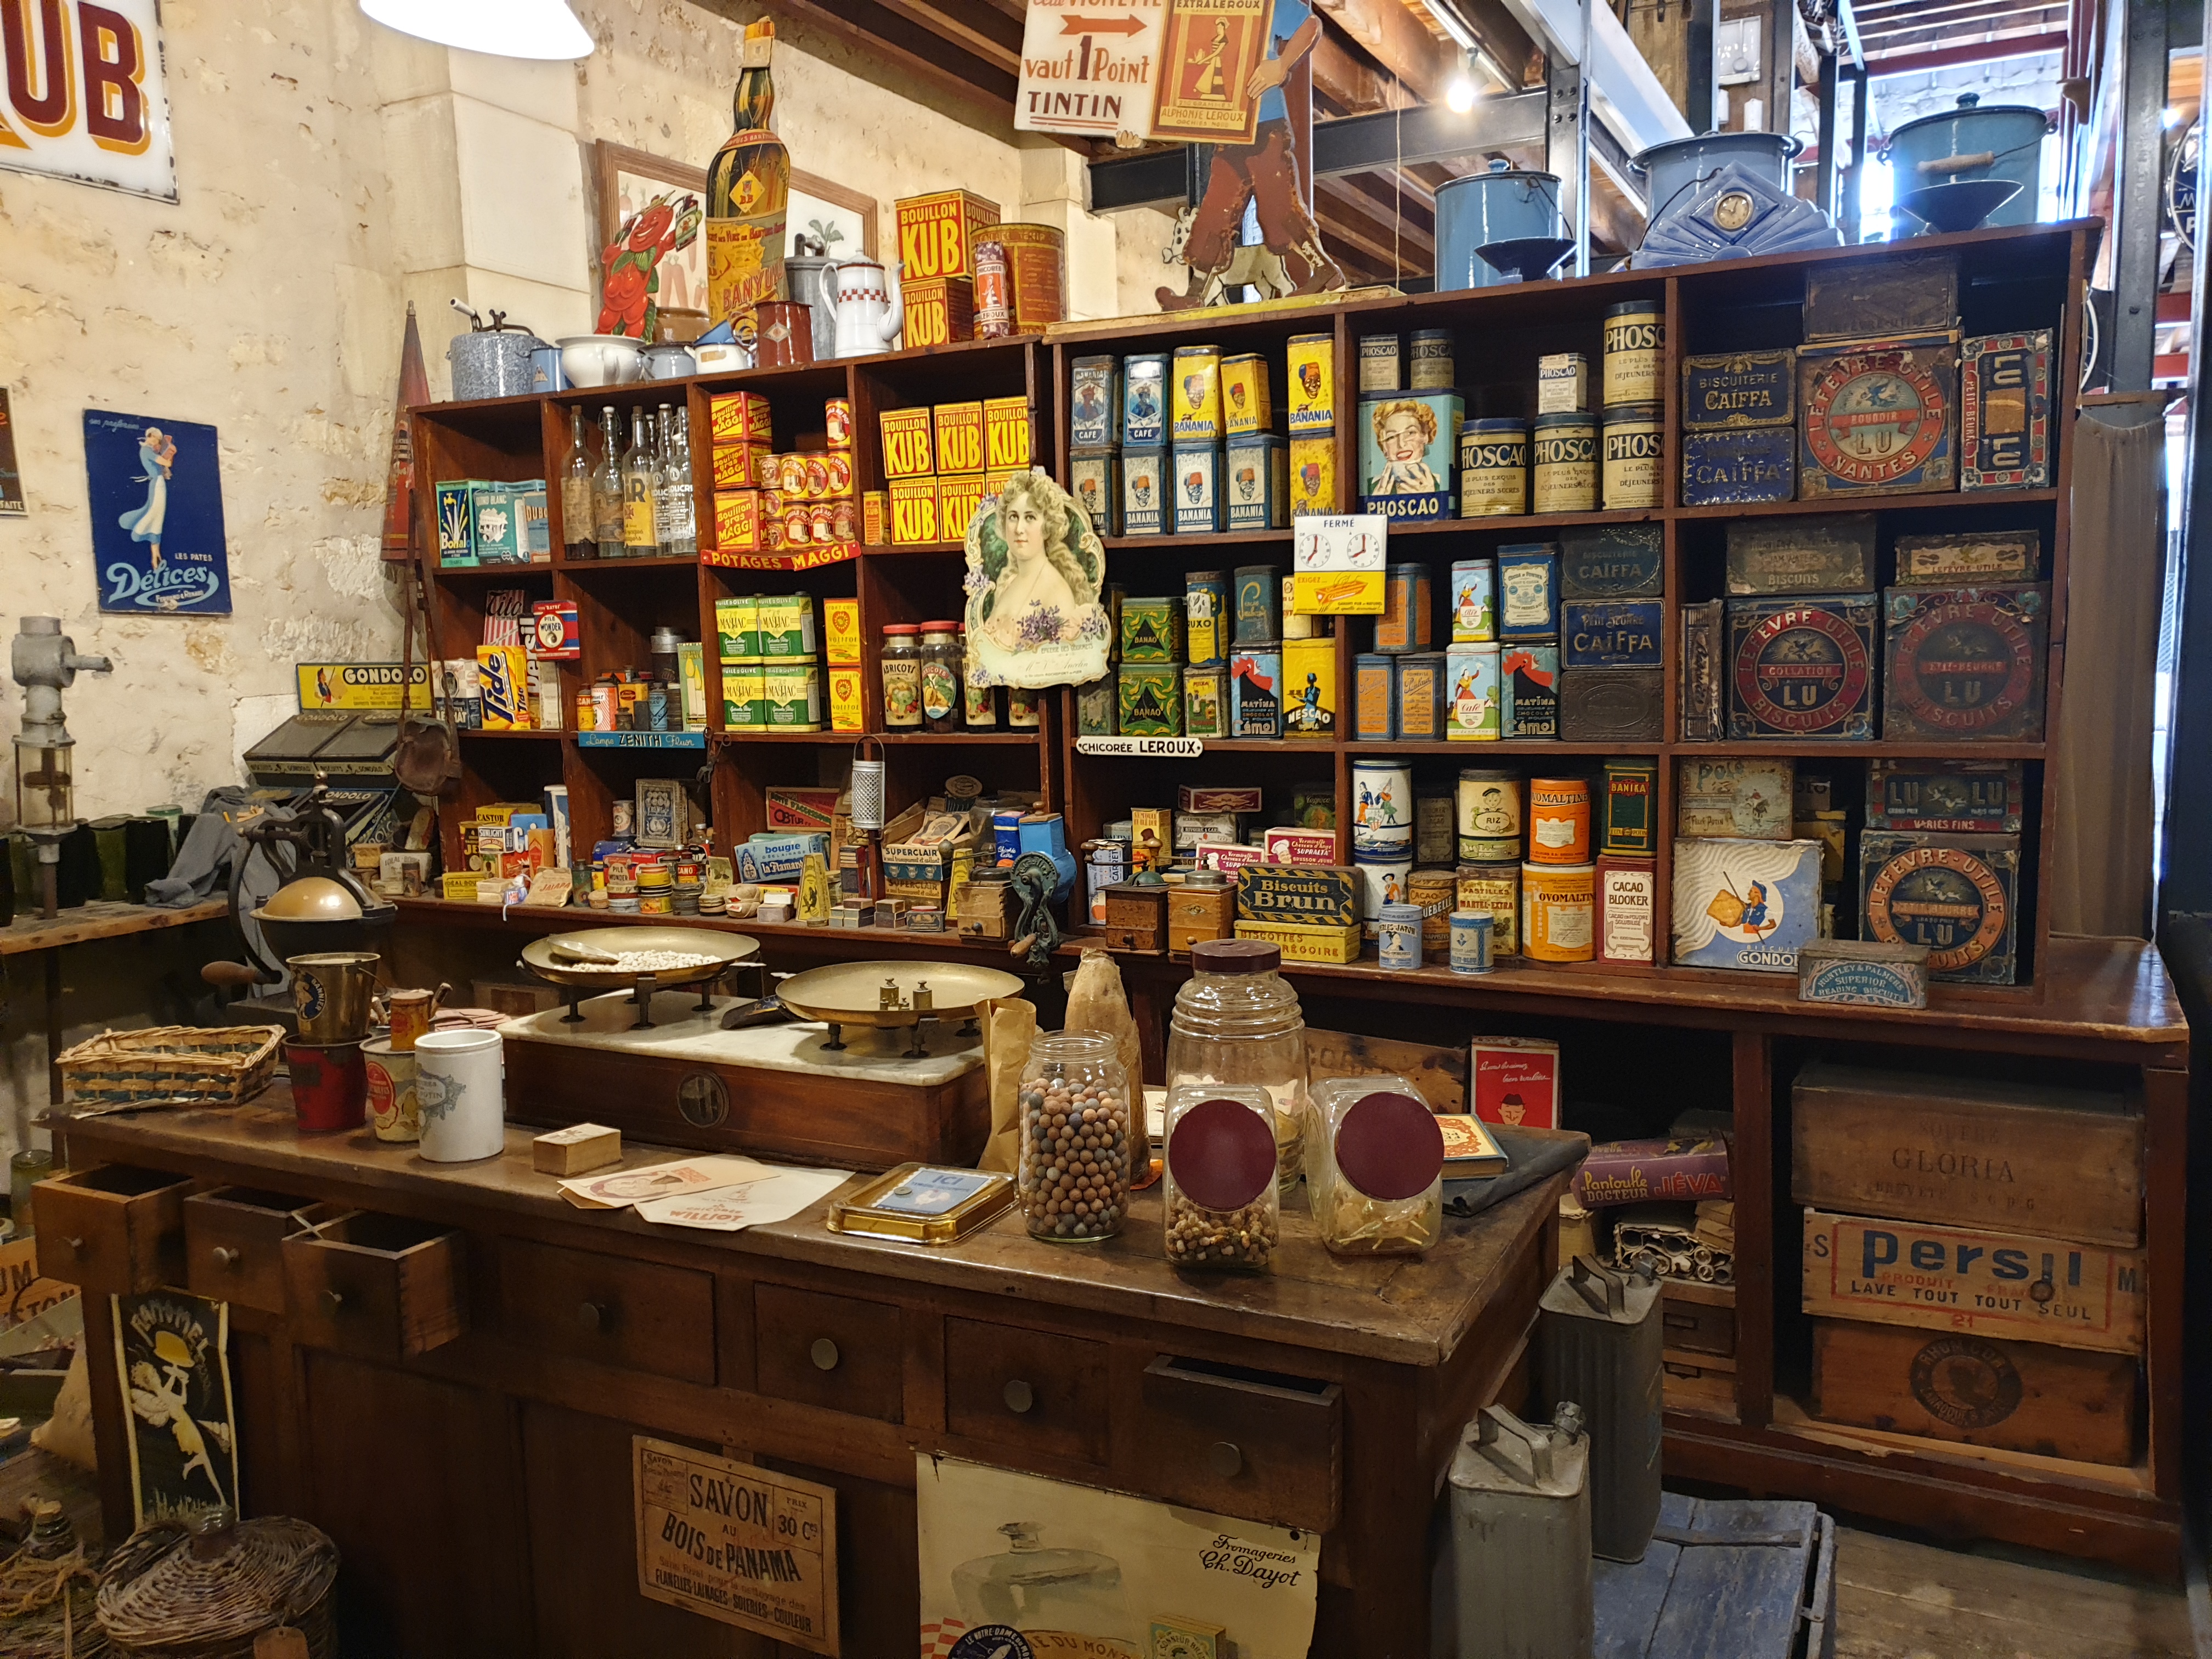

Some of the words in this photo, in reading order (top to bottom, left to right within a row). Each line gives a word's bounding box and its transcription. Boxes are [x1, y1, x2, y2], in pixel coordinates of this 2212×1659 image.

[1213, 1, 1260, 9] LEROUX
[1024, 50, 1073, 80] vaut
[1077, 35, 1092, 80] 1
[1092, 48, 1150, 83] Point
[0, 0, 151, 155] UB
[1028, 91, 1121, 119] TINTIN
[1161, 108, 1203, 120] ALPHONSE
[1206, 109, 1243, 121] LEROUX
[901, 202, 957, 225] BOUILLON
[966, 203, 999, 223] BOUILLON
[901, 219, 960, 279] KUB
[723, 257, 784, 312] BANYULS
[905, 288, 943, 304] BOUILLON
[980, 311, 1006, 319] LEROUX
[906, 301, 946, 348] KUB
[1361, 346, 1397, 356] PHOSCAO
[1540, 367, 1576, 379] PHOSCAO
[1993, 354, 2023, 385] LU
[1699, 371, 1778, 388] BISCUITERIE
[1705, 388, 1773, 410] CAÏFFA
[712, 402, 741, 421] Bouillon
[717, 411, 735, 424] gras
[938, 413, 978, 426] BOUILLON
[988, 408, 1028, 422] BOUILLON
[1289, 409, 1332, 424] BANANIA
[1850, 411, 1898, 424] BOUDOIR
[713, 413, 742, 434] MAGGI
[884, 418, 926, 433] BOUILLON
[1174, 420, 1215, 433] BANANIA
[1226, 416, 1257, 429] BANANIA
[938, 425, 981, 470] KUB
[988, 420, 1029, 466] KUB
[1855, 432, 1892, 454] LU
[714, 450, 743, 468] Bouillon
[885, 430, 929, 475] KUB
[1462, 445, 1526, 467] HOSCAO
[1993, 438, 2022, 466] LU
[714, 462, 744, 483] MAGGI
[719, 458, 738, 471] gras
[1830, 450, 1918, 479] NANTES
[630, 478, 645, 503] R
[892, 486, 933, 500] BOUILLON
[941, 483, 981, 496] BOUILLON
[717, 504, 751, 523] Bouillon
[1178, 509, 1212, 521] BANANIA
[1231, 506, 1263, 518] BANANIA
[1367, 498, 1439, 517] PHOSCAO
[725, 514, 745, 526] gras
[893, 499, 935, 541] KUB
[1126, 514, 1159, 525] BANANIA
[1324, 518, 1355, 527] FERMÉ
[718, 520, 752, 543] MAGGI
[190, 554, 213, 562] PATES
[712, 552, 782, 569] POTAGES
[793, 545, 849, 569] MAGGI
[106, 559, 208, 603] Délices
[1768, 573, 1819, 585] BISCUITS
[540, 623, 562, 631] WONDER
[1573, 632, 1653, 653] CAÏFFA
[345, 668, 425, 684] GONDOO
[883, 663, 917, 676] ABRICOTS
[1769, 665, 1832, 677] COLLATION
[478, 651, 516, 724] Tide
[1783, 684, 1818, 707] LU
[1944, 681, 1981, 703] LU
[517, 688, 527, 712] Tide
[1460, 702, 1481, 712] Café
[1134, 708, 1161, 716] BANAO
[1288, 708, 1330, 725] NESCAO
[1751, 697, 1847, 729] BISCUITS
[1911, 695, 2013, 729] BISCUITS
[586, 733, 614, 746] Lampe
[619, 734, 662, 747] ZENITH
[665, 735, 695, 746] Fluor
[1081, 742, 1133, 752] CHICORÉE
[1139, 741, 1195, 754] LEROUX
[1611, 782, 1646, 793] BANIKA
[1889, 782, 1918, 805] LU
[1971, 781, 2003, 804] LU
[477, 814, 504, 823] CASTOR
[1913, 819, 1949, 831] VARIÉS
[1951, 820, 1975, 830] FINS
[479, 828, 503, 838] SUNLIGHT
[765, 843, 801, 854] bougie
[1261, 880, 1328, 895] Biscuits
[1410, 889, 1437, 899] CACAO
[1613, 882, 1644, 893] CACAO
[1253, 890, 1336, 911] Brun
[1539, 892, 1595, 904] OVOMALTIN
[1609, 895, 1649, 906] BLOOKER
[1240, 930, 1304, 943] BISCOTTES
[1917, 924, 1953, 946] LU
[1281, 944, 1339, 957] RÉGOIRE
[1738, 950, 1798, 966] GONDOL
[1818, 964, 1855, 988] HUNTLEY
[1865, 964, 1905, 991] PALMERS
[1835, 974, 1887, 988] SUPERIOR
[1819, 986, 1857, 996] READING
[1863, 986, 1905, 1001] BISCUITS
[1892, 1147, 2016, 1184] GLORIA
[933, 1175, 963, 1186] ICI
[1587, 1188, 1649, 1203] DOCTEUR
[670, 1210, 744, 1222] WILLIOT
[1814, 1234, 1829, 1258] S
[1882, 1272, 1954, 1289] PRODUIT
[2117, 1267, 2136, 1293] M
[1851, 1280, 1896, 1297] LAVE
[1913, 1288, 1959, 1304] TOUT
[1974, 1294, 2021, 1312] TOUT
[2039, 1302, 2091, 1321] SEUL
[690, 1474, 768, 1528] SAVON
[786, 1497, 807, 1509] PRIX
[722, 1524, 737, 1536] AU
[778, 1515, 797, 1536] 30
[661, 1511, 706, 1561] BOIS
[706, 1545, 723, 1570] DE
[726, 1542, 802, 1583] PANAMA
[1212, 1533, 1296, 1565] Fromageries
[1199, 1550, 1230, 1573] Ch.
[1233, 1556, 1302, 1589] Dayot
[732, 1593, 768, 1619] SOIERIES
[774, 1606, 811, 1632] COULEUR
[788, 1599, 806, 1611] des
